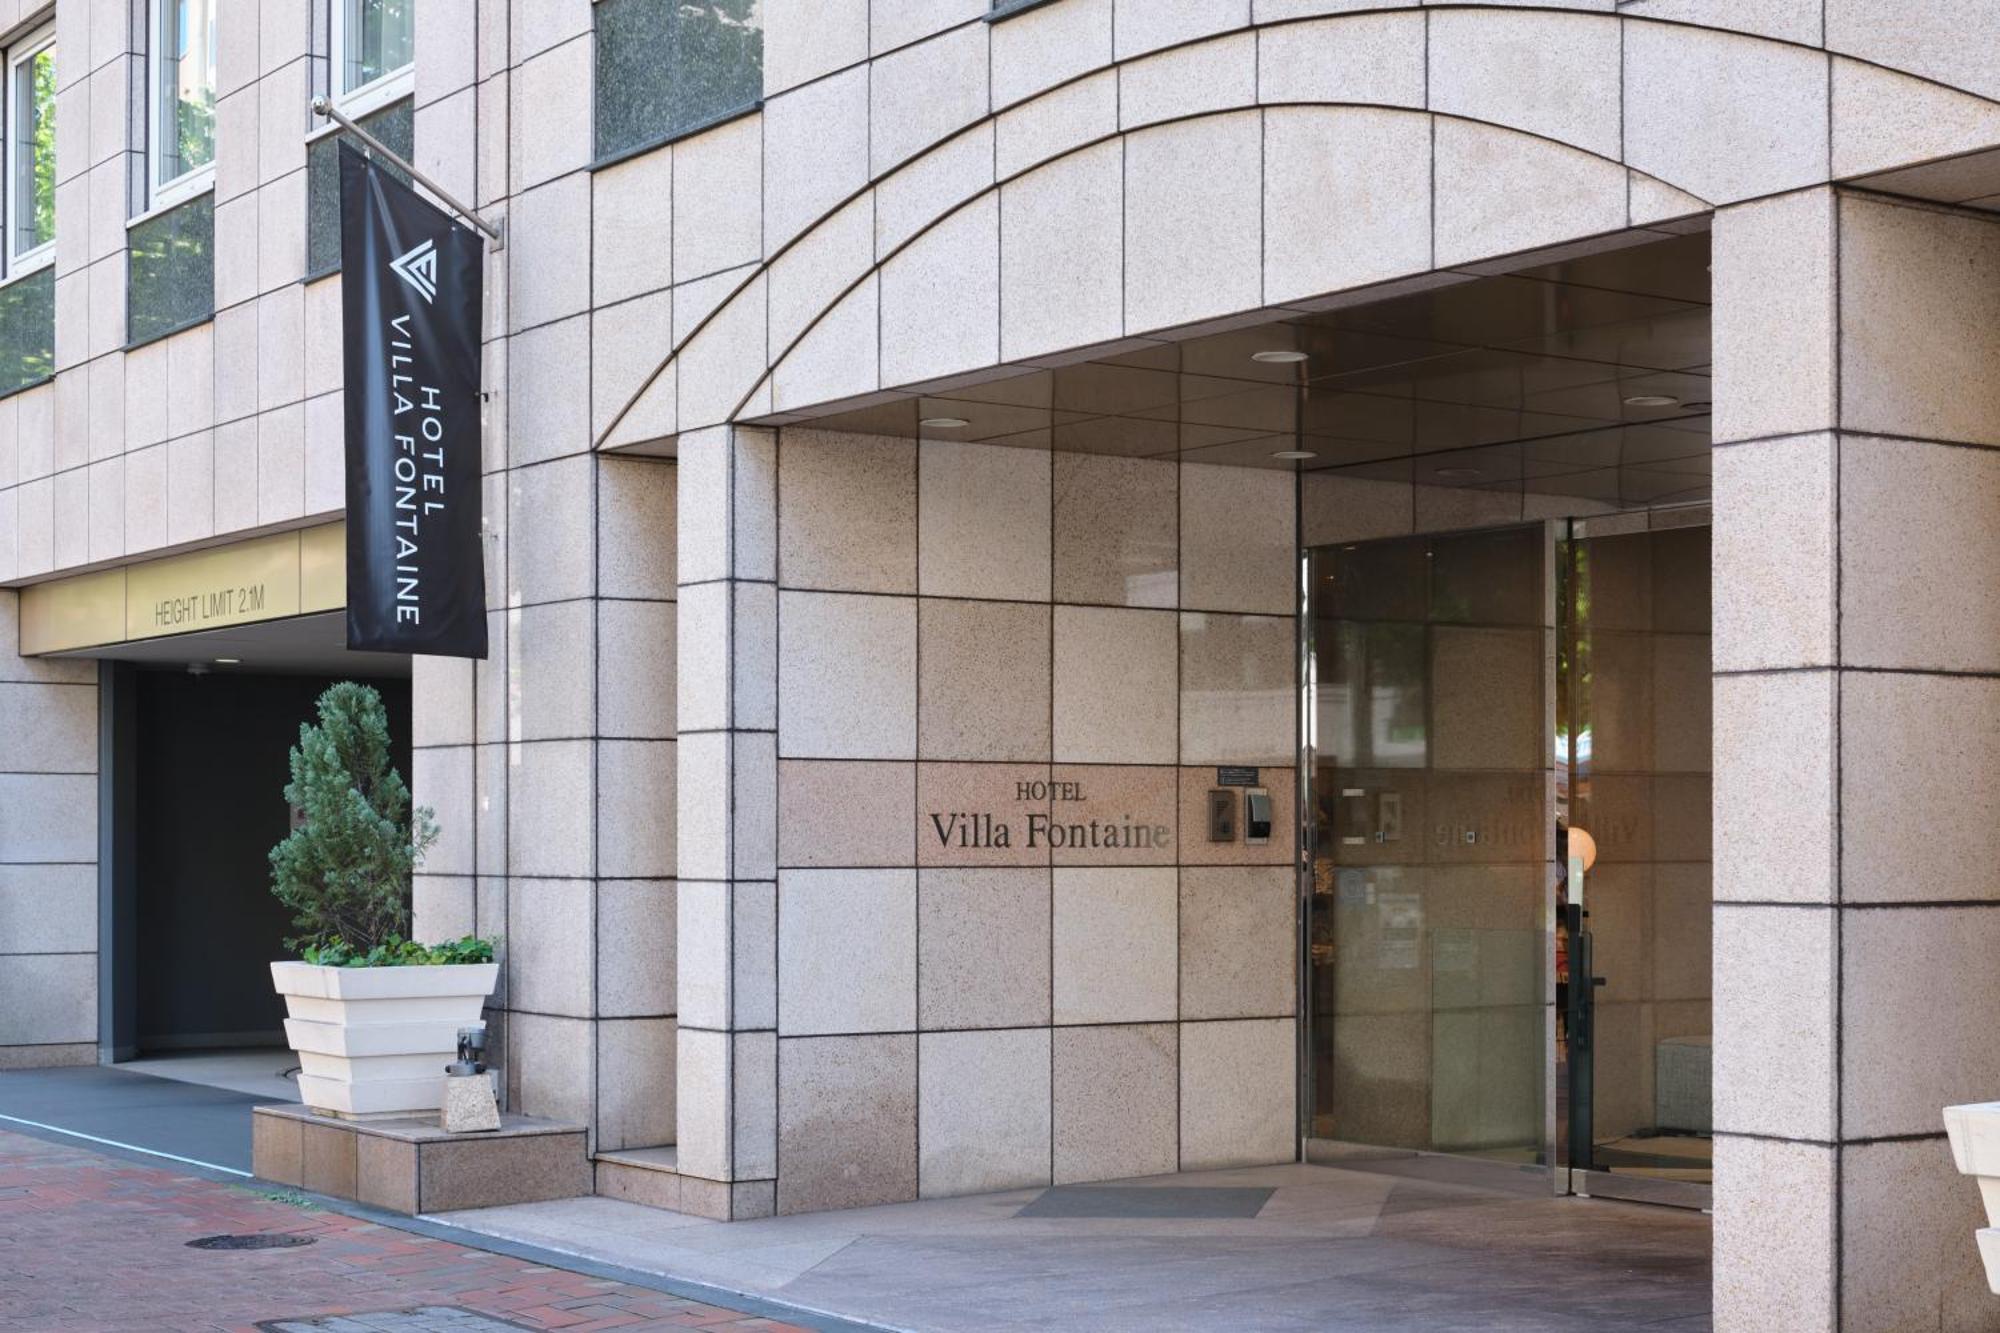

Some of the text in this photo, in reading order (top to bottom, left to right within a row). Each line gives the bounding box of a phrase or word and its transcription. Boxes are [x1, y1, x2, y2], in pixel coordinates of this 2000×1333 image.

[391, 314, 419, 625] VILLA FONTAINE
[420, 386, 445, 515] HOTEL
[155, 584, 265, 626] HEIGHT LIMIT 2.1M
[1016, 781, 1087, 801] HOTEL
[930, 812, 1170, 849] Villa Fontaine
